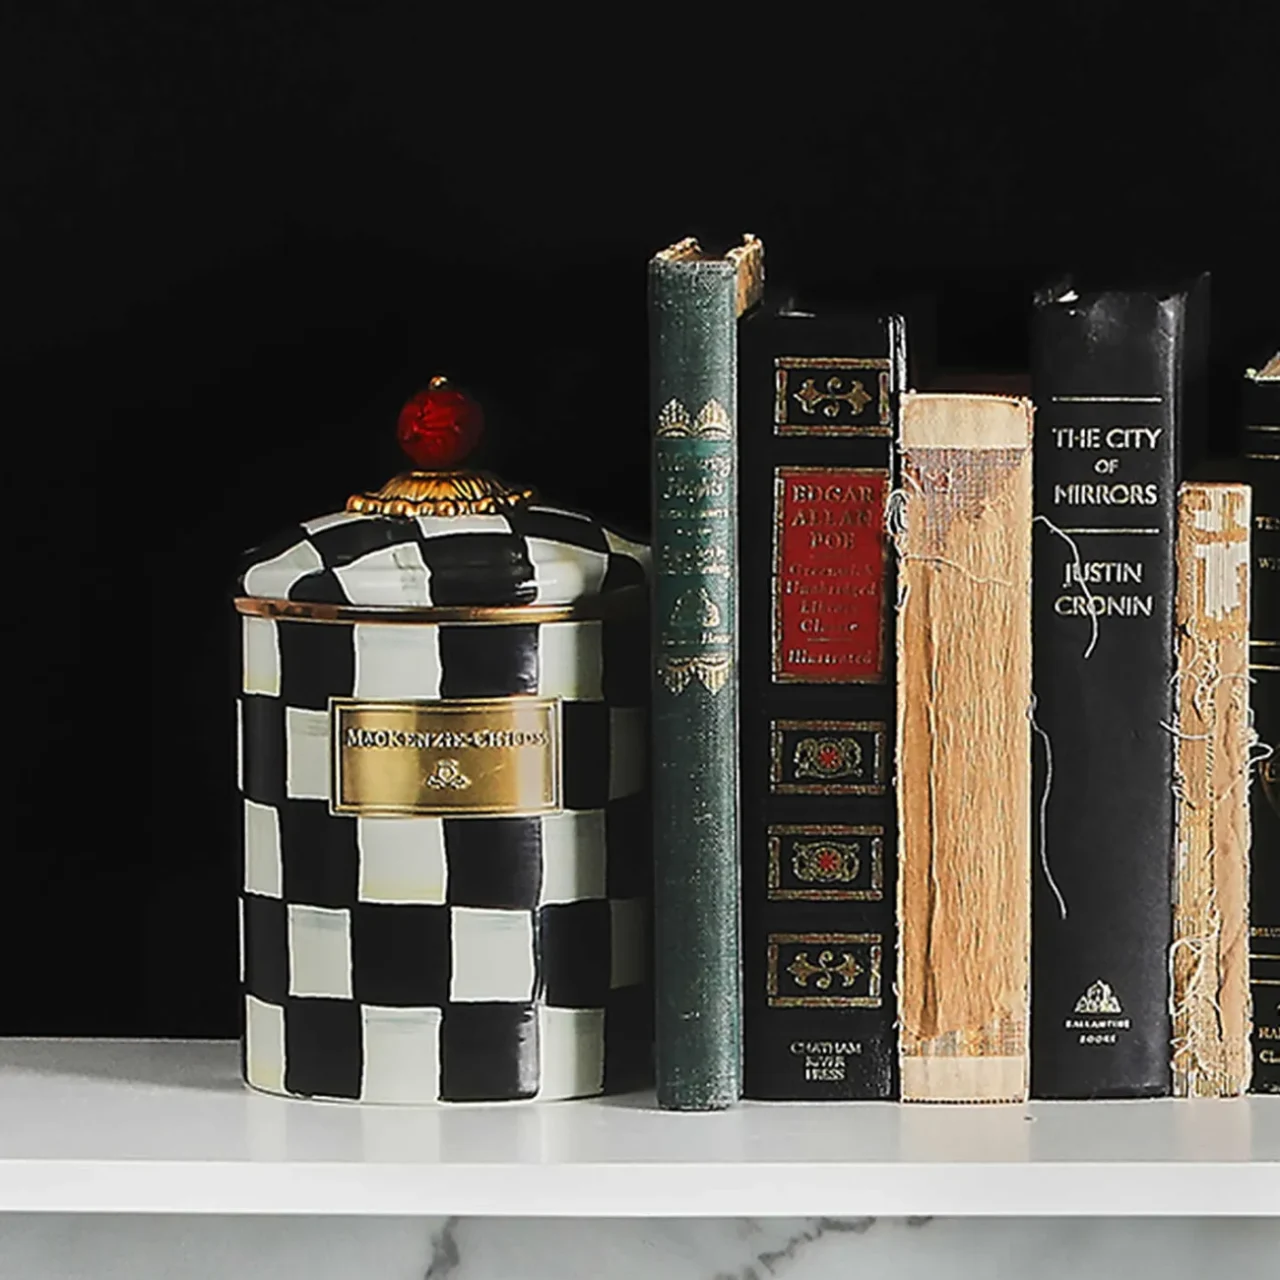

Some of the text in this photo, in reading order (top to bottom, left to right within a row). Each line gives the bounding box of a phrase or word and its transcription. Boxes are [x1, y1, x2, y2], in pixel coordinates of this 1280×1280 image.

[1052, 427, 1162, 449] THE CITY
[1094, 458, 1119, 474] OF
[792, 483, 874, 504] EDGAR
[1054, 484, 1158, 505] MIRRORS
[791, 507, 874, 527] ALLAN
[809, 530, 856, 549] POE
[1062, 562, 1143, 588] JUSTIN
[1054, 595, 1153, 617] CRONIN
